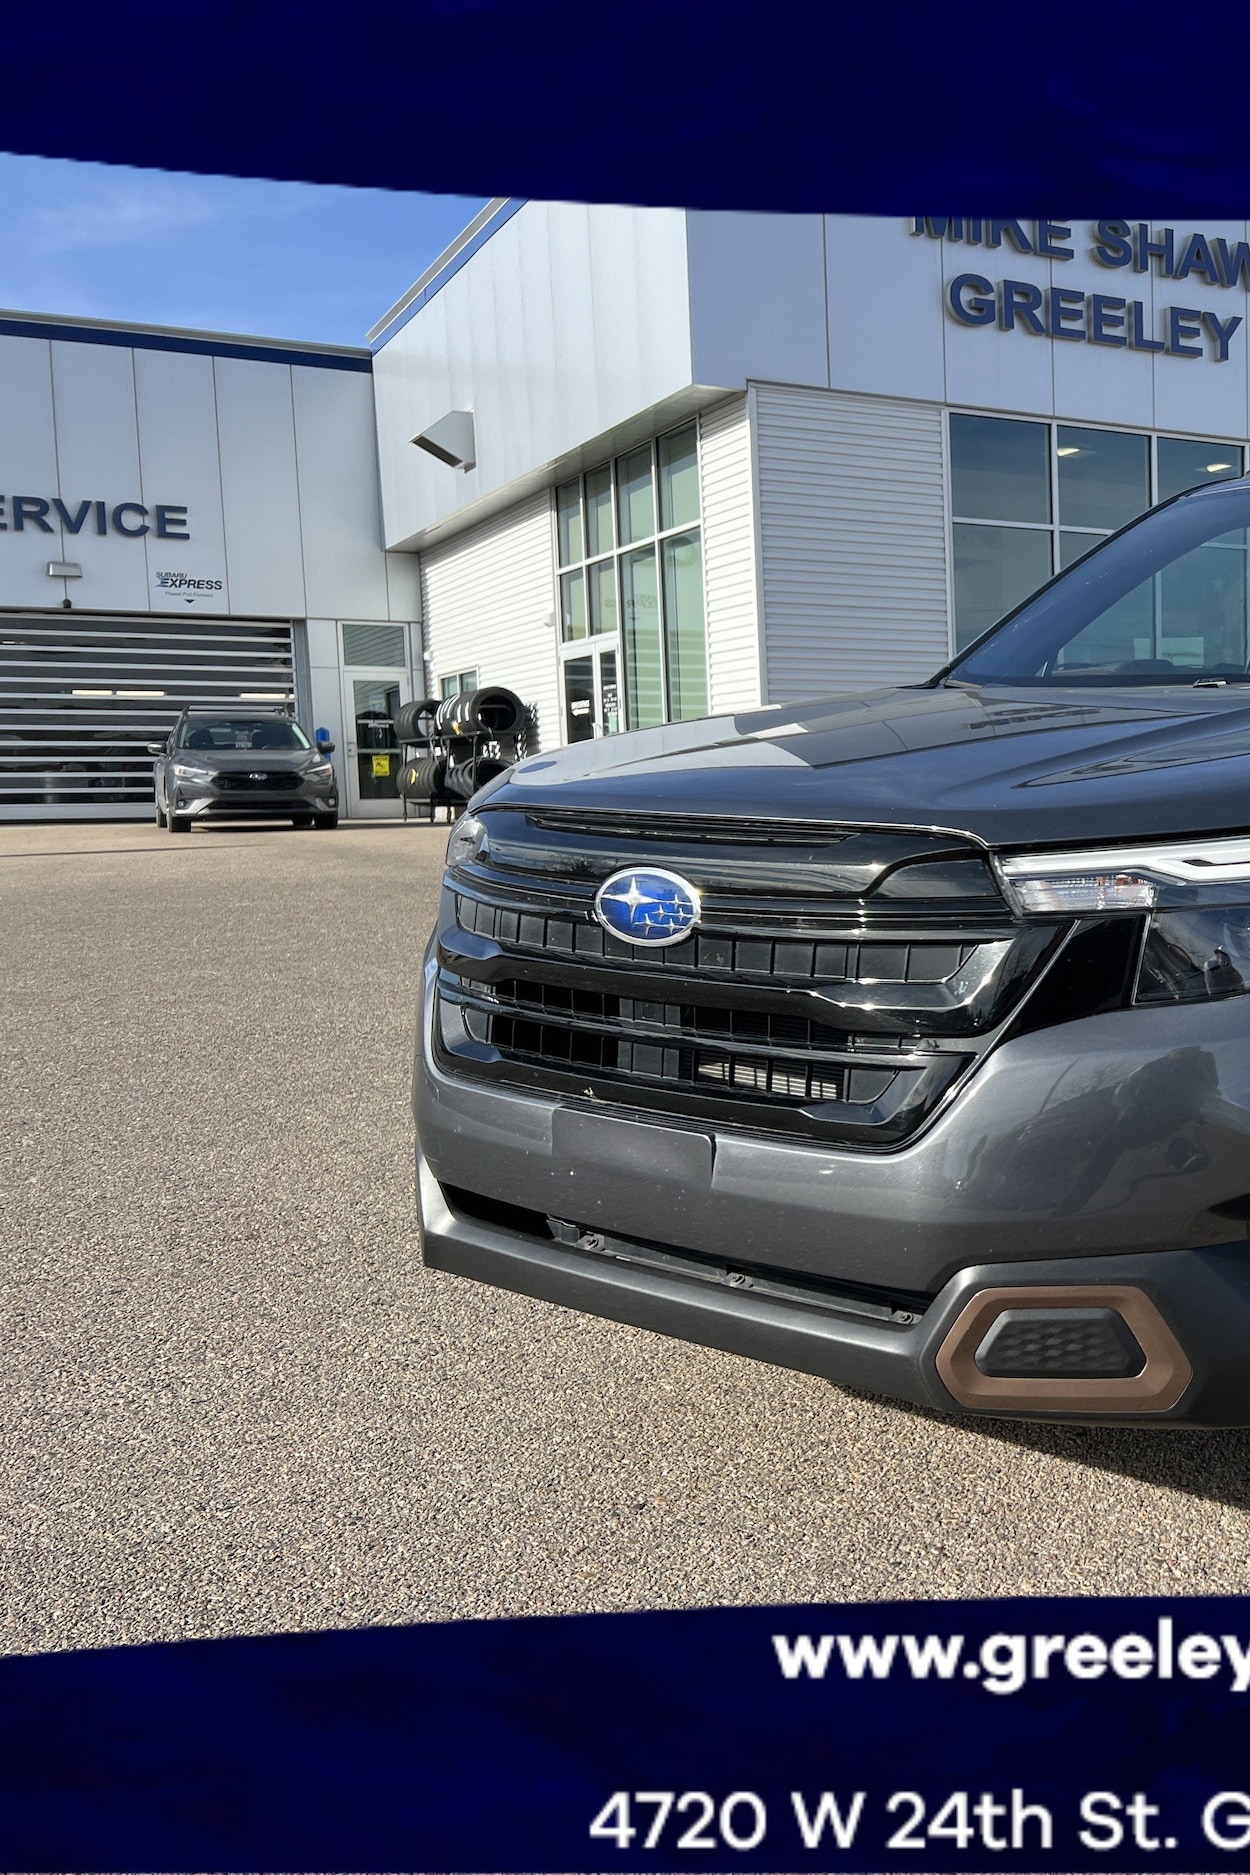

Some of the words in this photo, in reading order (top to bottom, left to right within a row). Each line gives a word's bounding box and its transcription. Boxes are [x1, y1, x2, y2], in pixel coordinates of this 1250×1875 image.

[945, 273, 1243, 362] GREELEY
[0, 494, 191, 541] RVICE
[155, 577, 223, 591] EXPRESS
[156, 571, 188, 579] SUBARU
